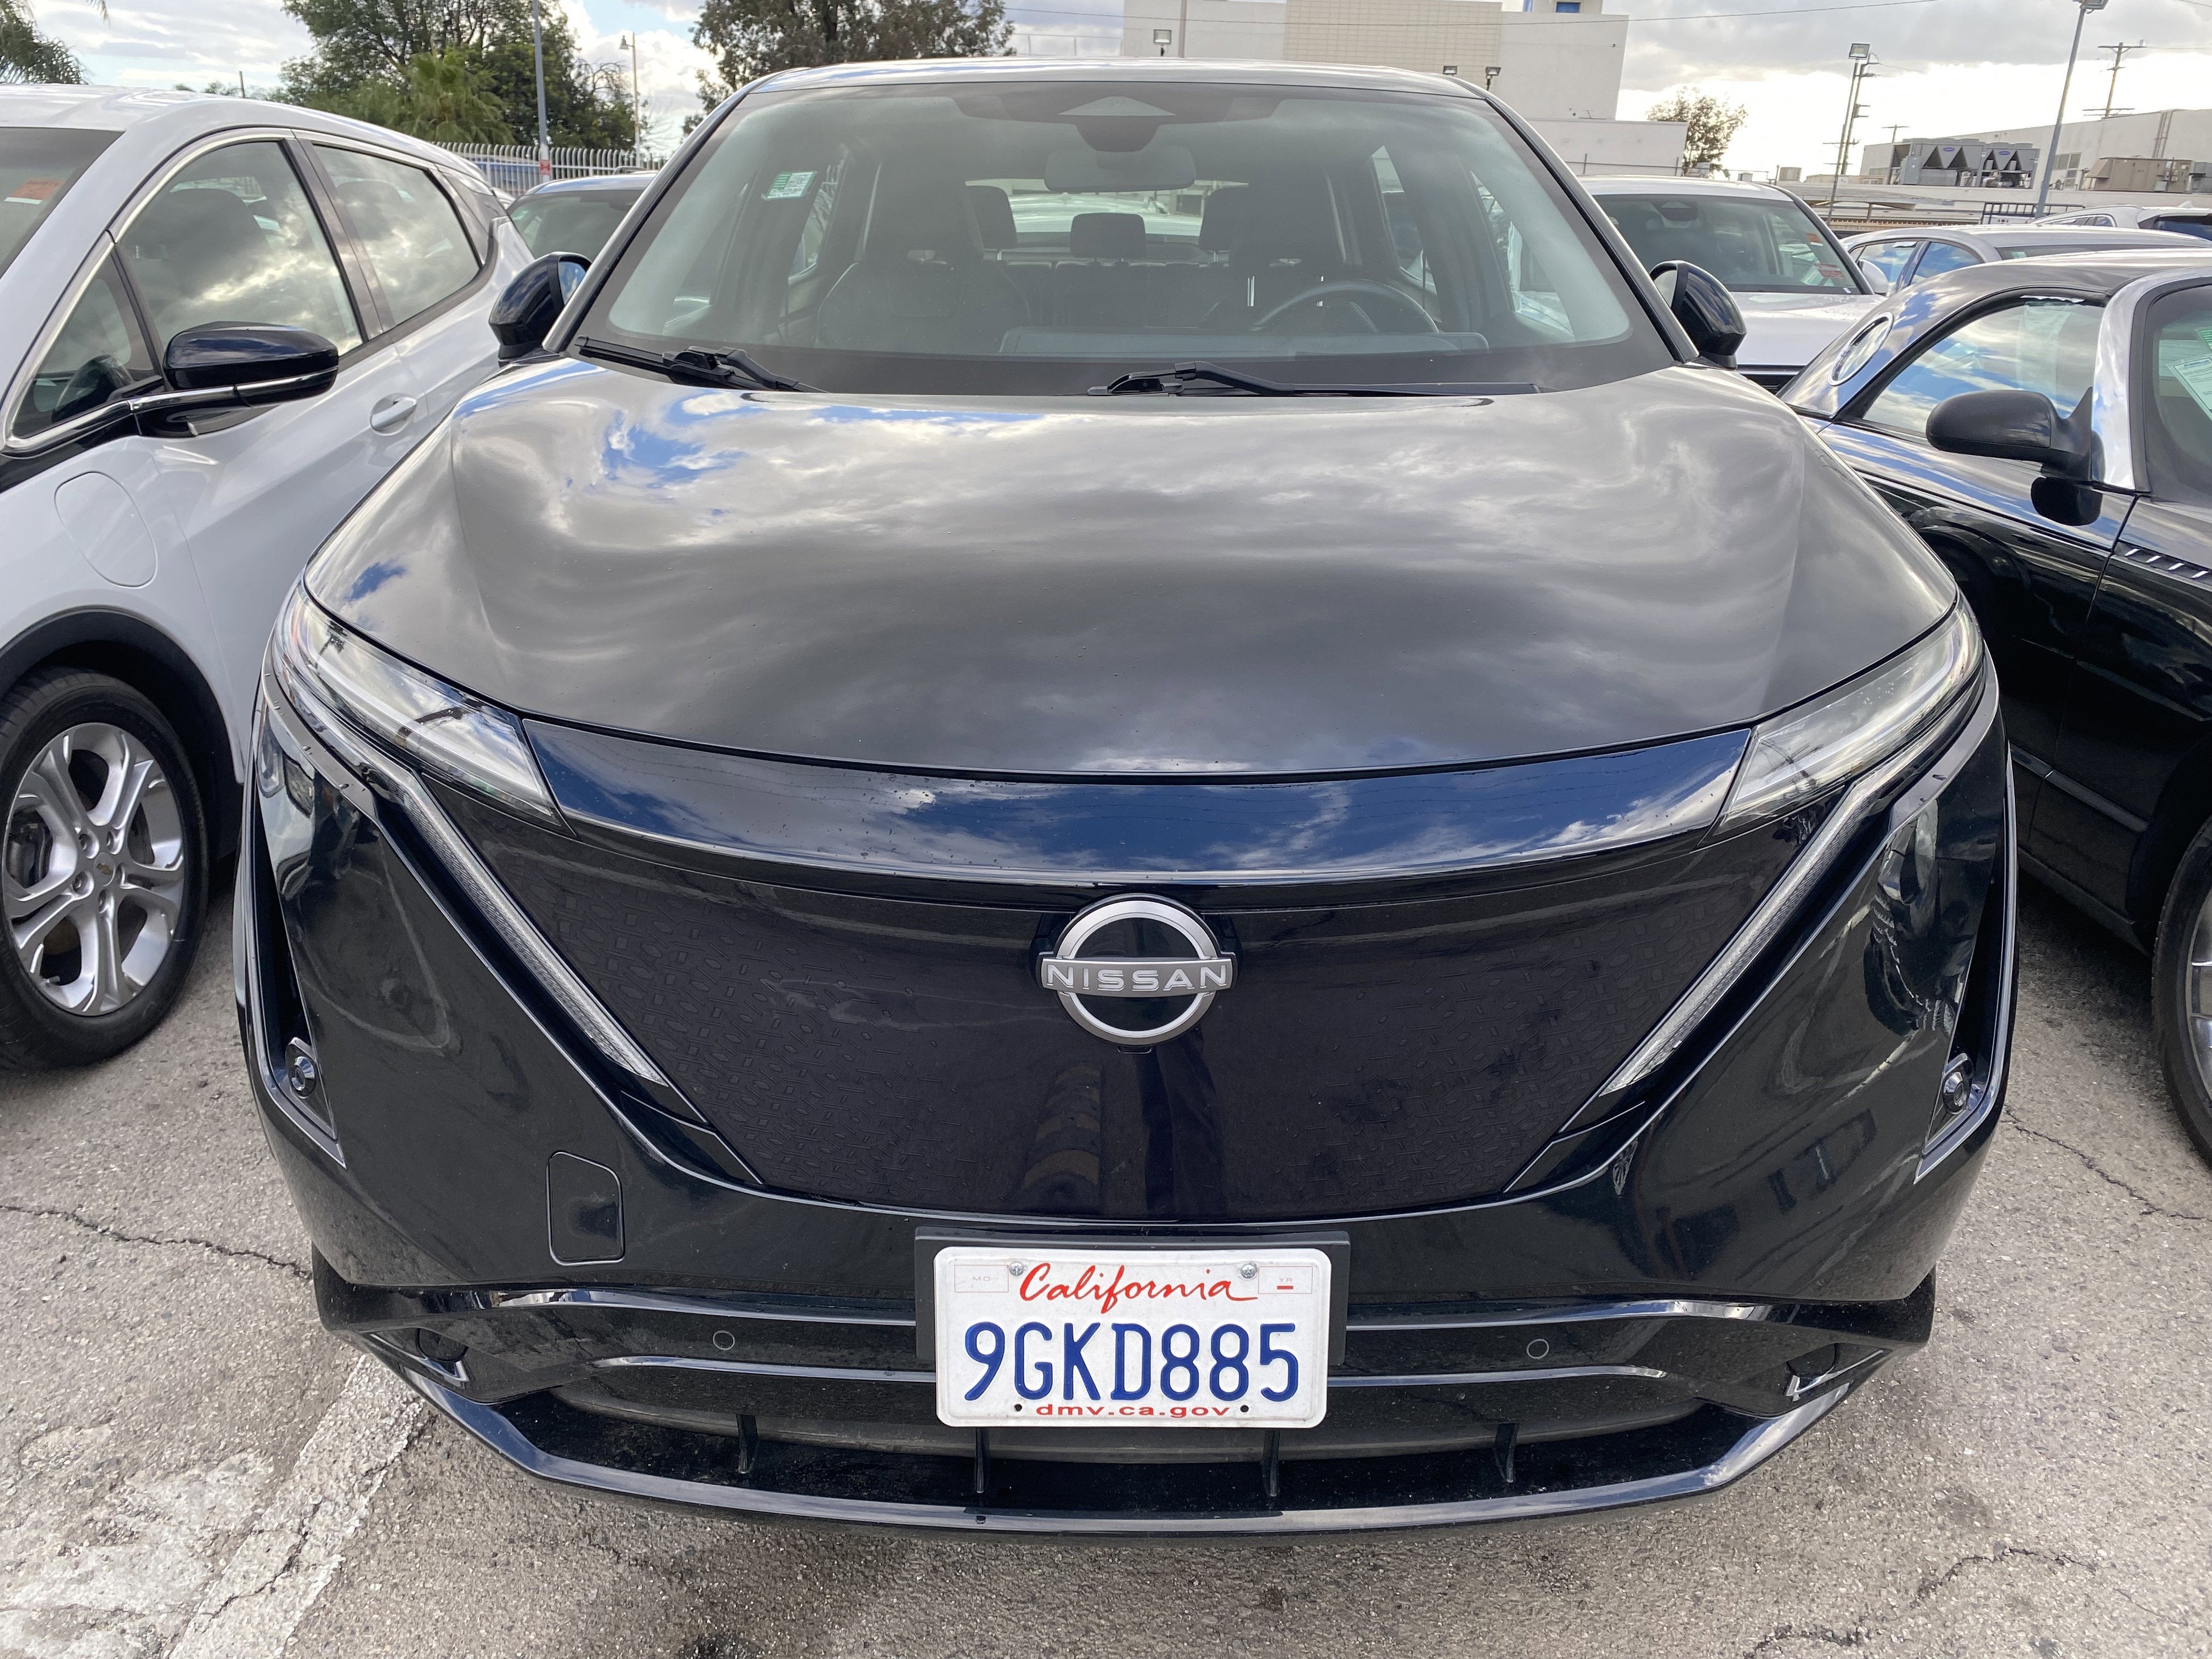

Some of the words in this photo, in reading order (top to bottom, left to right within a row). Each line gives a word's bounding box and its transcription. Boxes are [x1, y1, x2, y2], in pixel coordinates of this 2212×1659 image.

[1046, 964, 1228, 992] NISSAN
[1019, 1262, 1259, 1314] California
[964, 1322, 1299, 1402] 9GKD885
[1035, 1404, 1231, 1419] dmv.ca.gov
